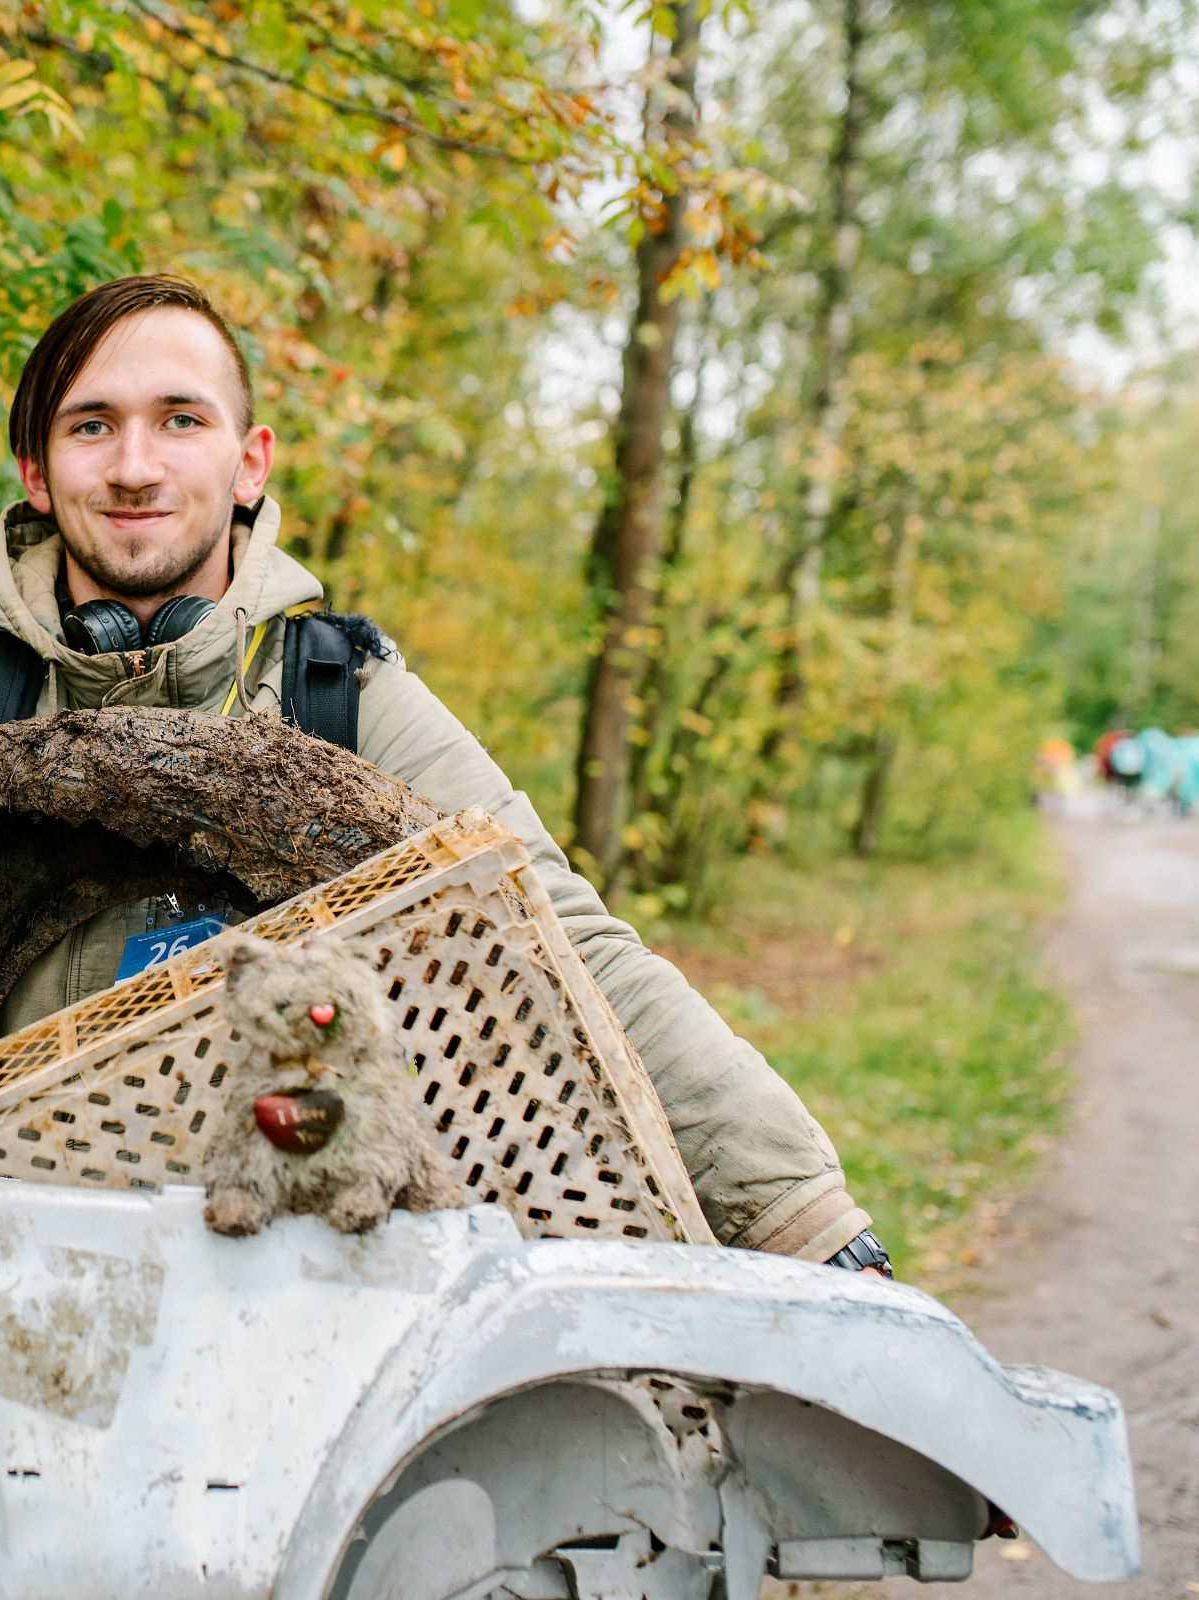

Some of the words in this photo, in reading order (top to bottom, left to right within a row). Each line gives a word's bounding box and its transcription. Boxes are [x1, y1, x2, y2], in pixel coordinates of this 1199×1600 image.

[144, 935, 190, 971] 26
[276, 1109, 287, 1126] I
[290, 1105, 327, 1123] Love
